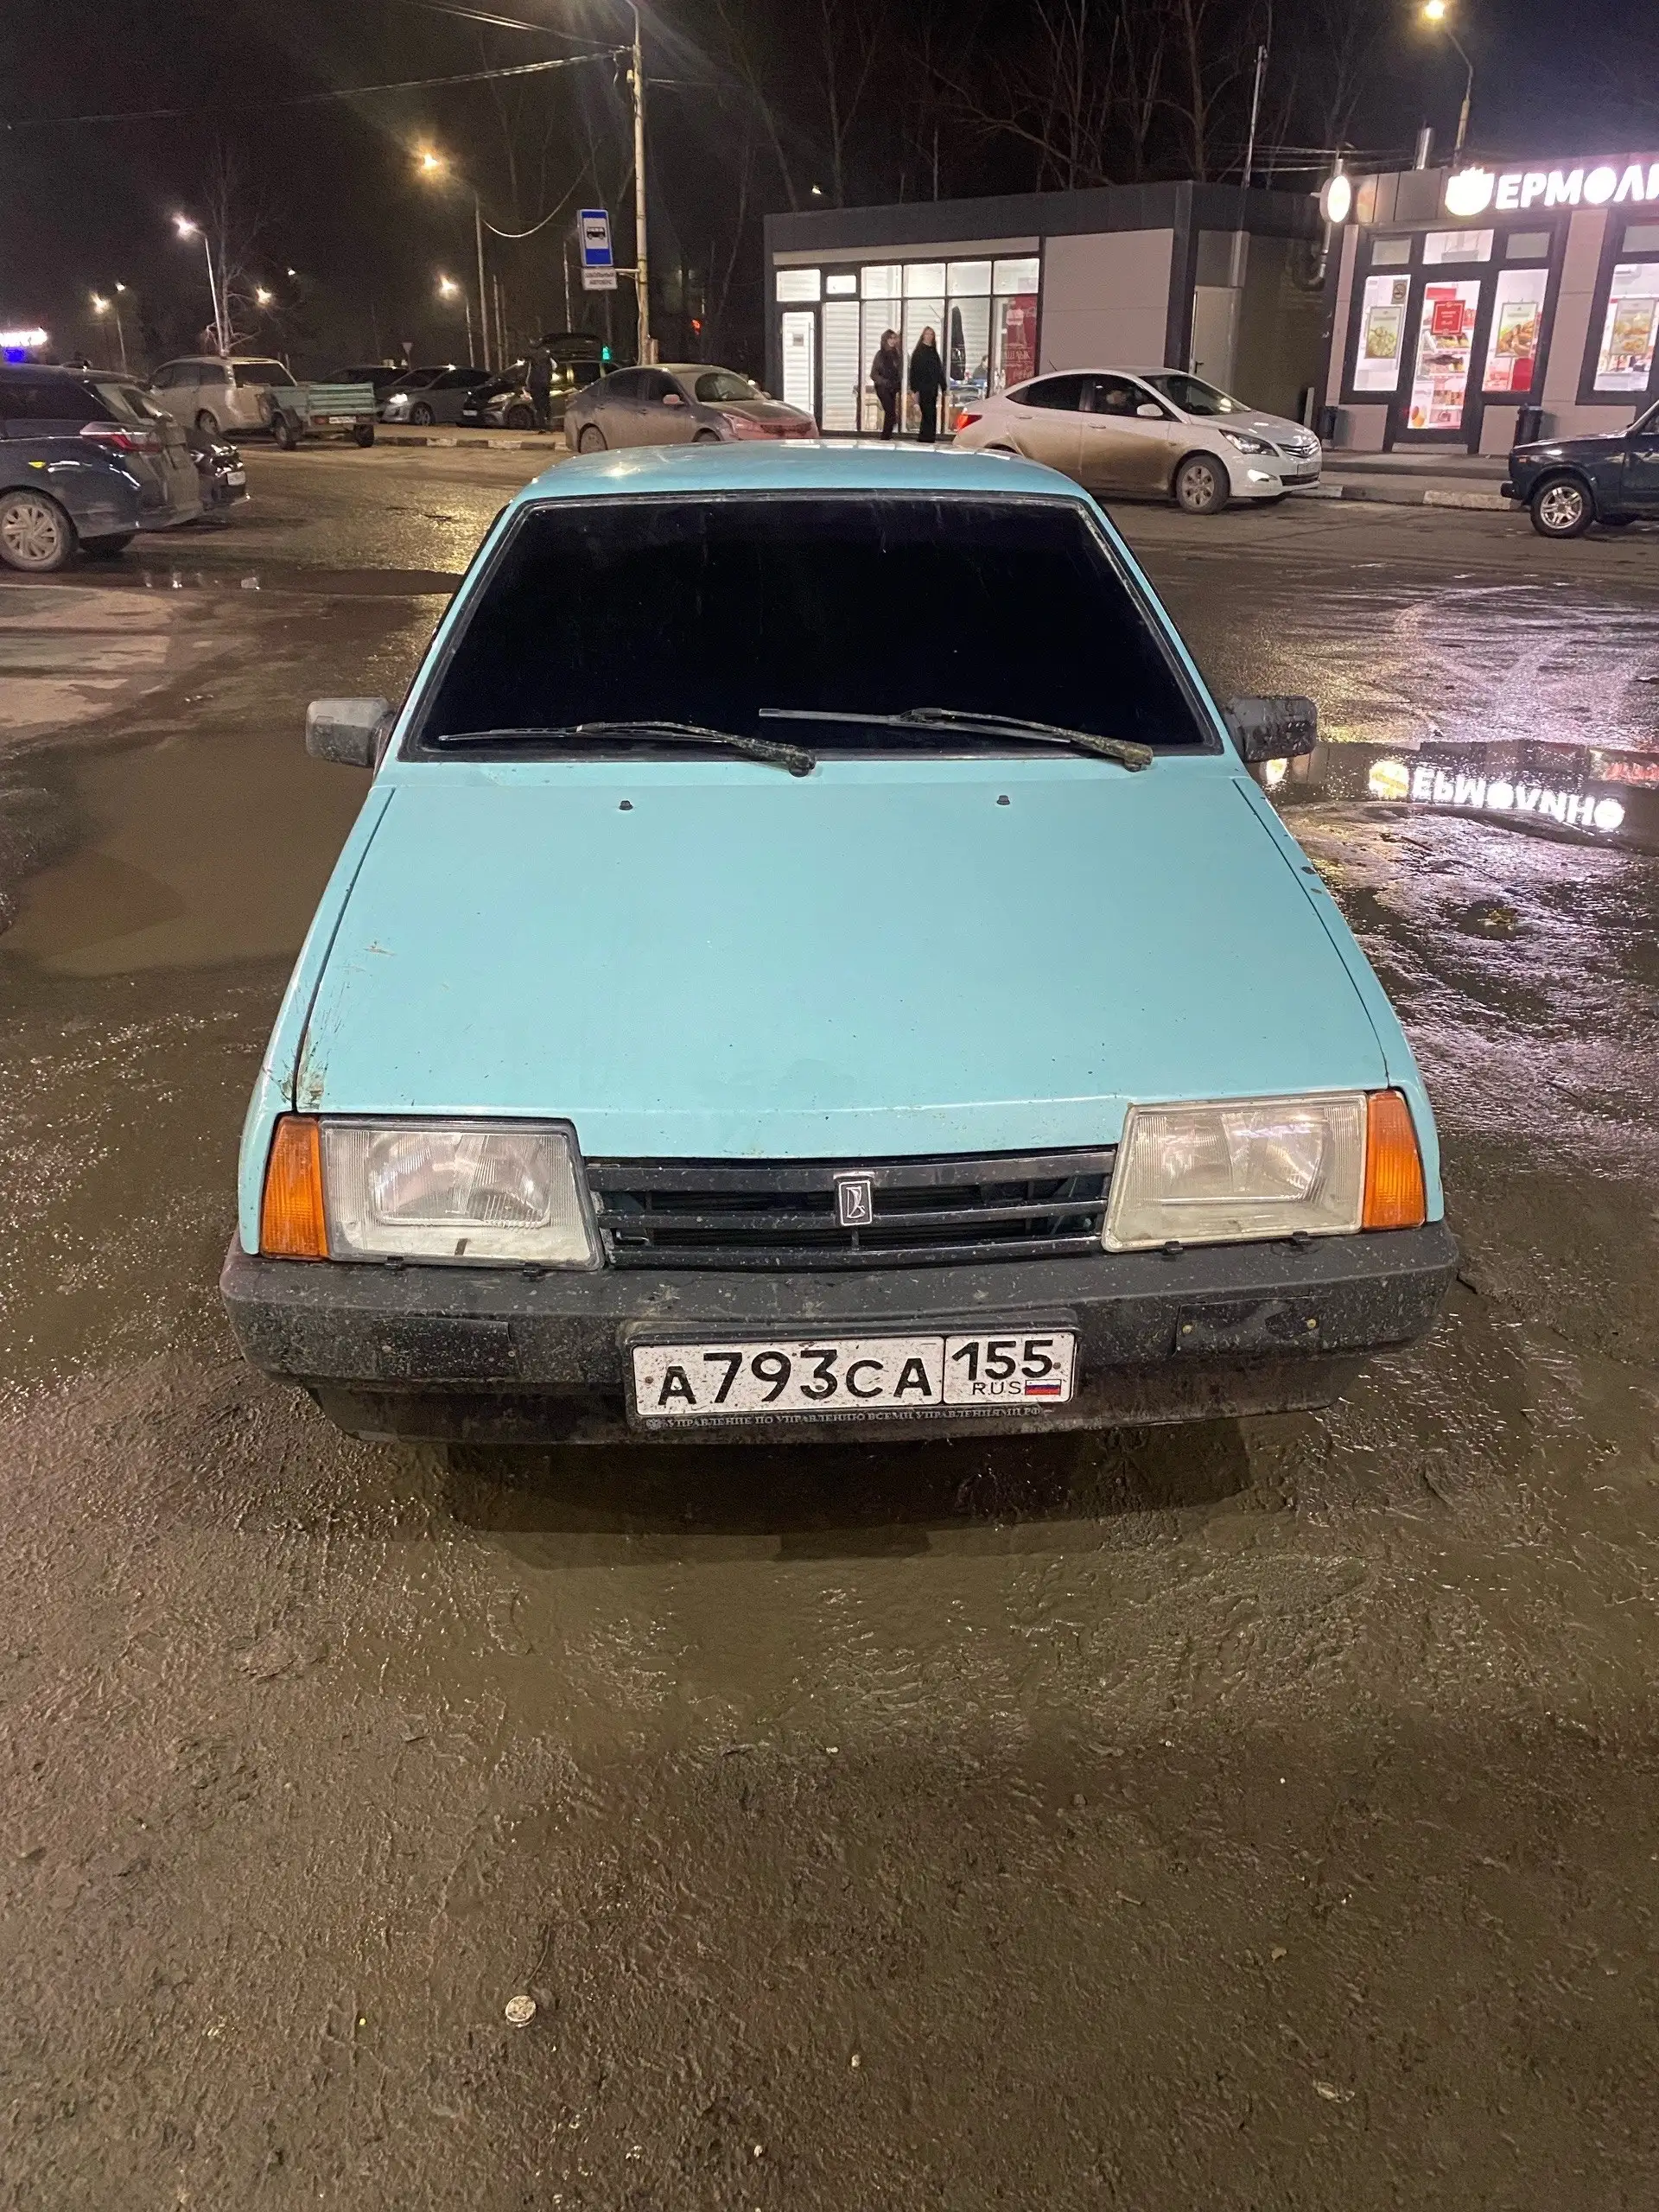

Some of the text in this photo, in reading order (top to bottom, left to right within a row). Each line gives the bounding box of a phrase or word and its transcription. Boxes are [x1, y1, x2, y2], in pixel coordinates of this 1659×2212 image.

[952, 1339, 1053, 1381] 155
[658, 1349, 932, 1406] А793СА
[972, 1381, 1021, 1395] RUS
[667, 1415, 752, 1427] УПРАВЛЕНИЕ
[754, 1415, 774, 1425] ПО
[777, 1412, 865, 1424] УПРАВЛЕНИЮ
[868, 1408, 913, 1421] ВСЕМИ
[916, 1407, 1021, 1420] УПРАВЛЕНИЯМИ
